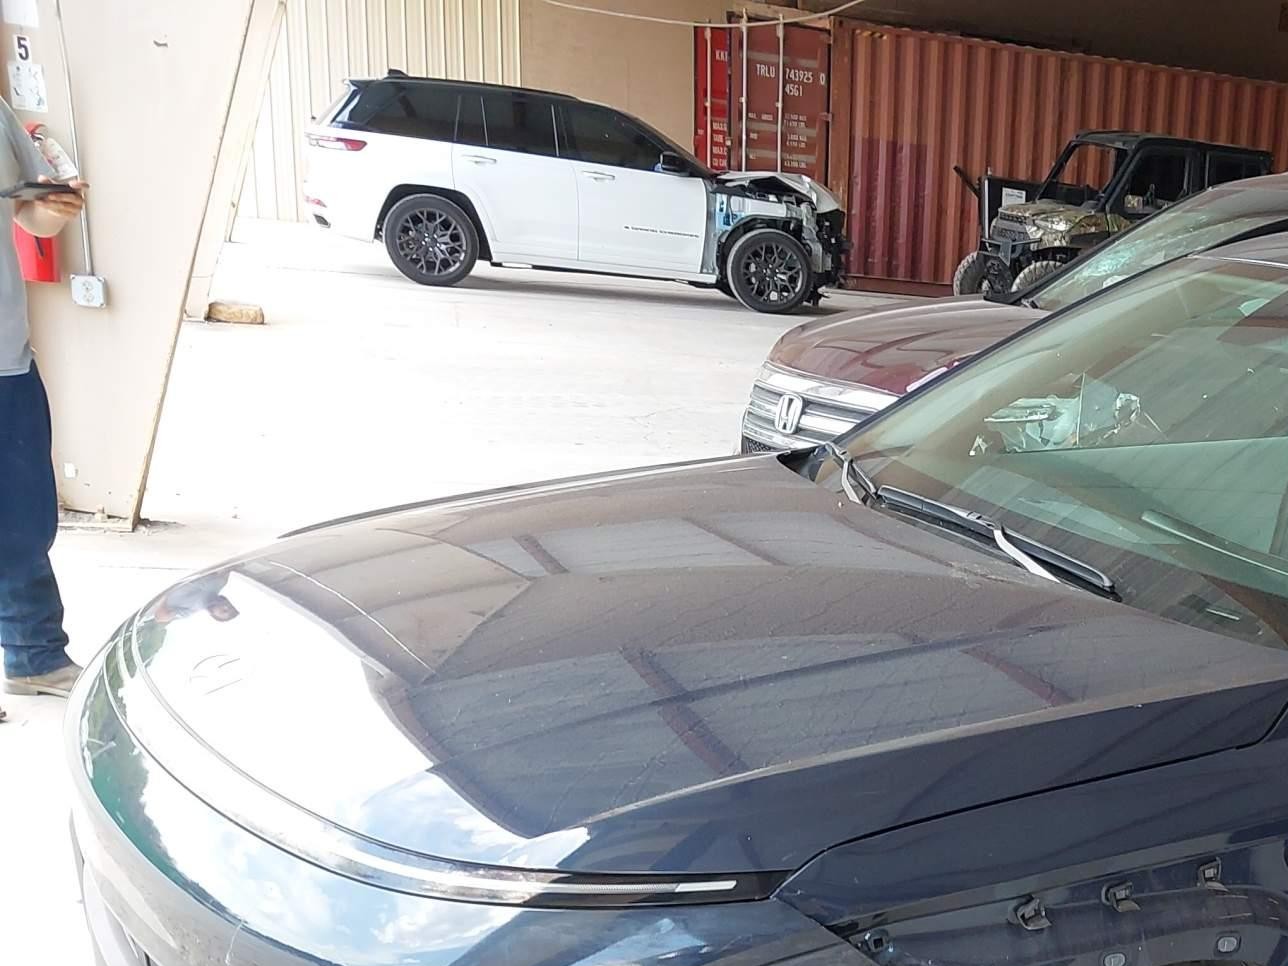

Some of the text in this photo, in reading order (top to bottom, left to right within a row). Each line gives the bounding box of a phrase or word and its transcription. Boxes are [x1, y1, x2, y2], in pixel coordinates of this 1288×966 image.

[16, 36, 30, 61] 5
[756, 64, 826, 85] TRLU 743925 0
